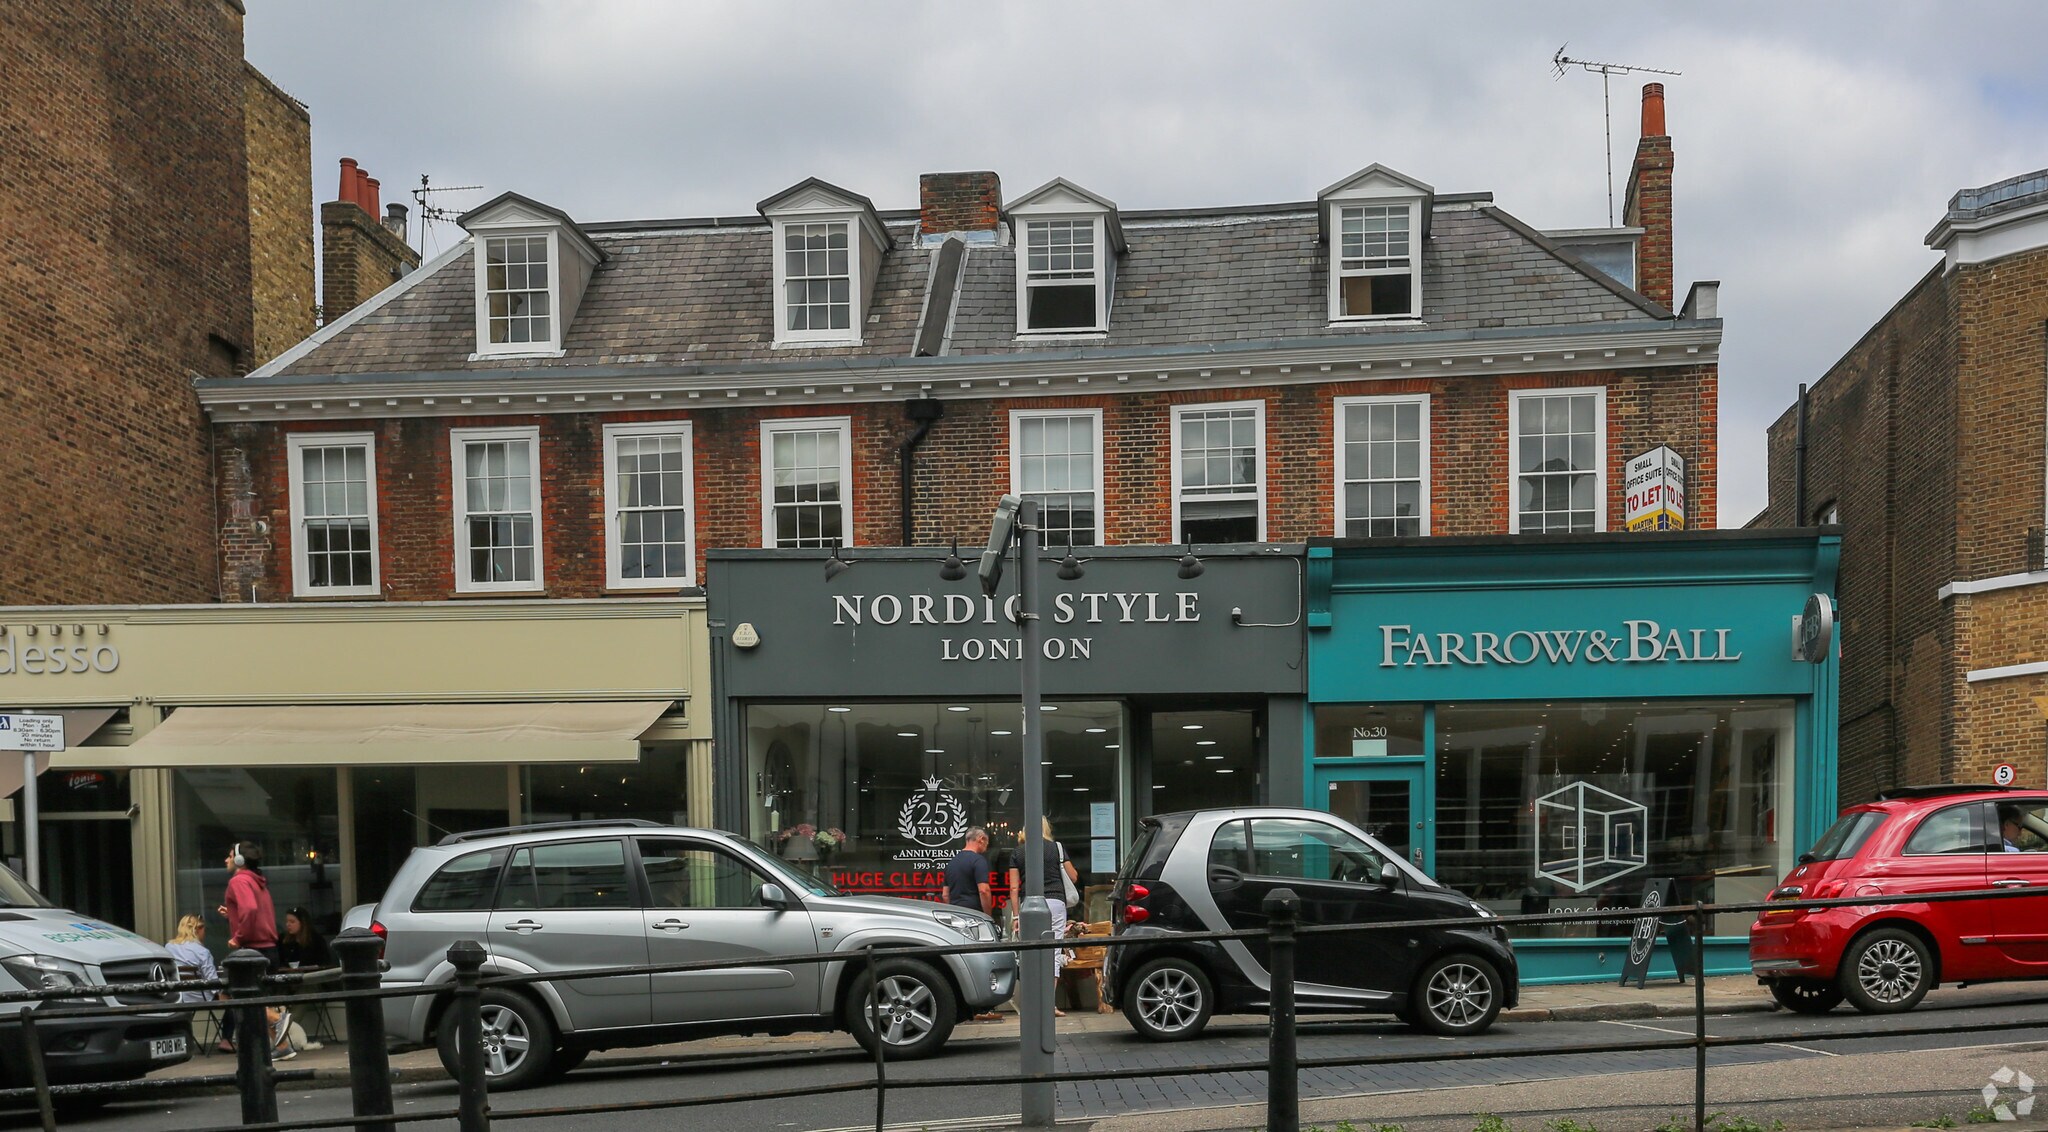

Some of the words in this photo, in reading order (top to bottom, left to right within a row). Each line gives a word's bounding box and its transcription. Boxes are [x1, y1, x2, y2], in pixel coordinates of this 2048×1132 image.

[1634, 458, 1652, 472] SMALL
[1627, 475, 1644, 490] OFFICE
[1645, 467, 1662, 482] SUITE
[1627, 494, 1639, 513] TO
[1642, 485, 1661, 507] LET
[1667, 485, 1675, 504] TO
[1053, 592, 1202, 625] STYLE
[2000, 767, 2008, 778] 5
[917, 802, 949, 825] 25
[918, 827, 948, 836] YEAR
[899, 849, 962, 858] ANNIVERSA
[913, 862, 931, 870] 1993
[833, 872, 884, 887] HUGE
